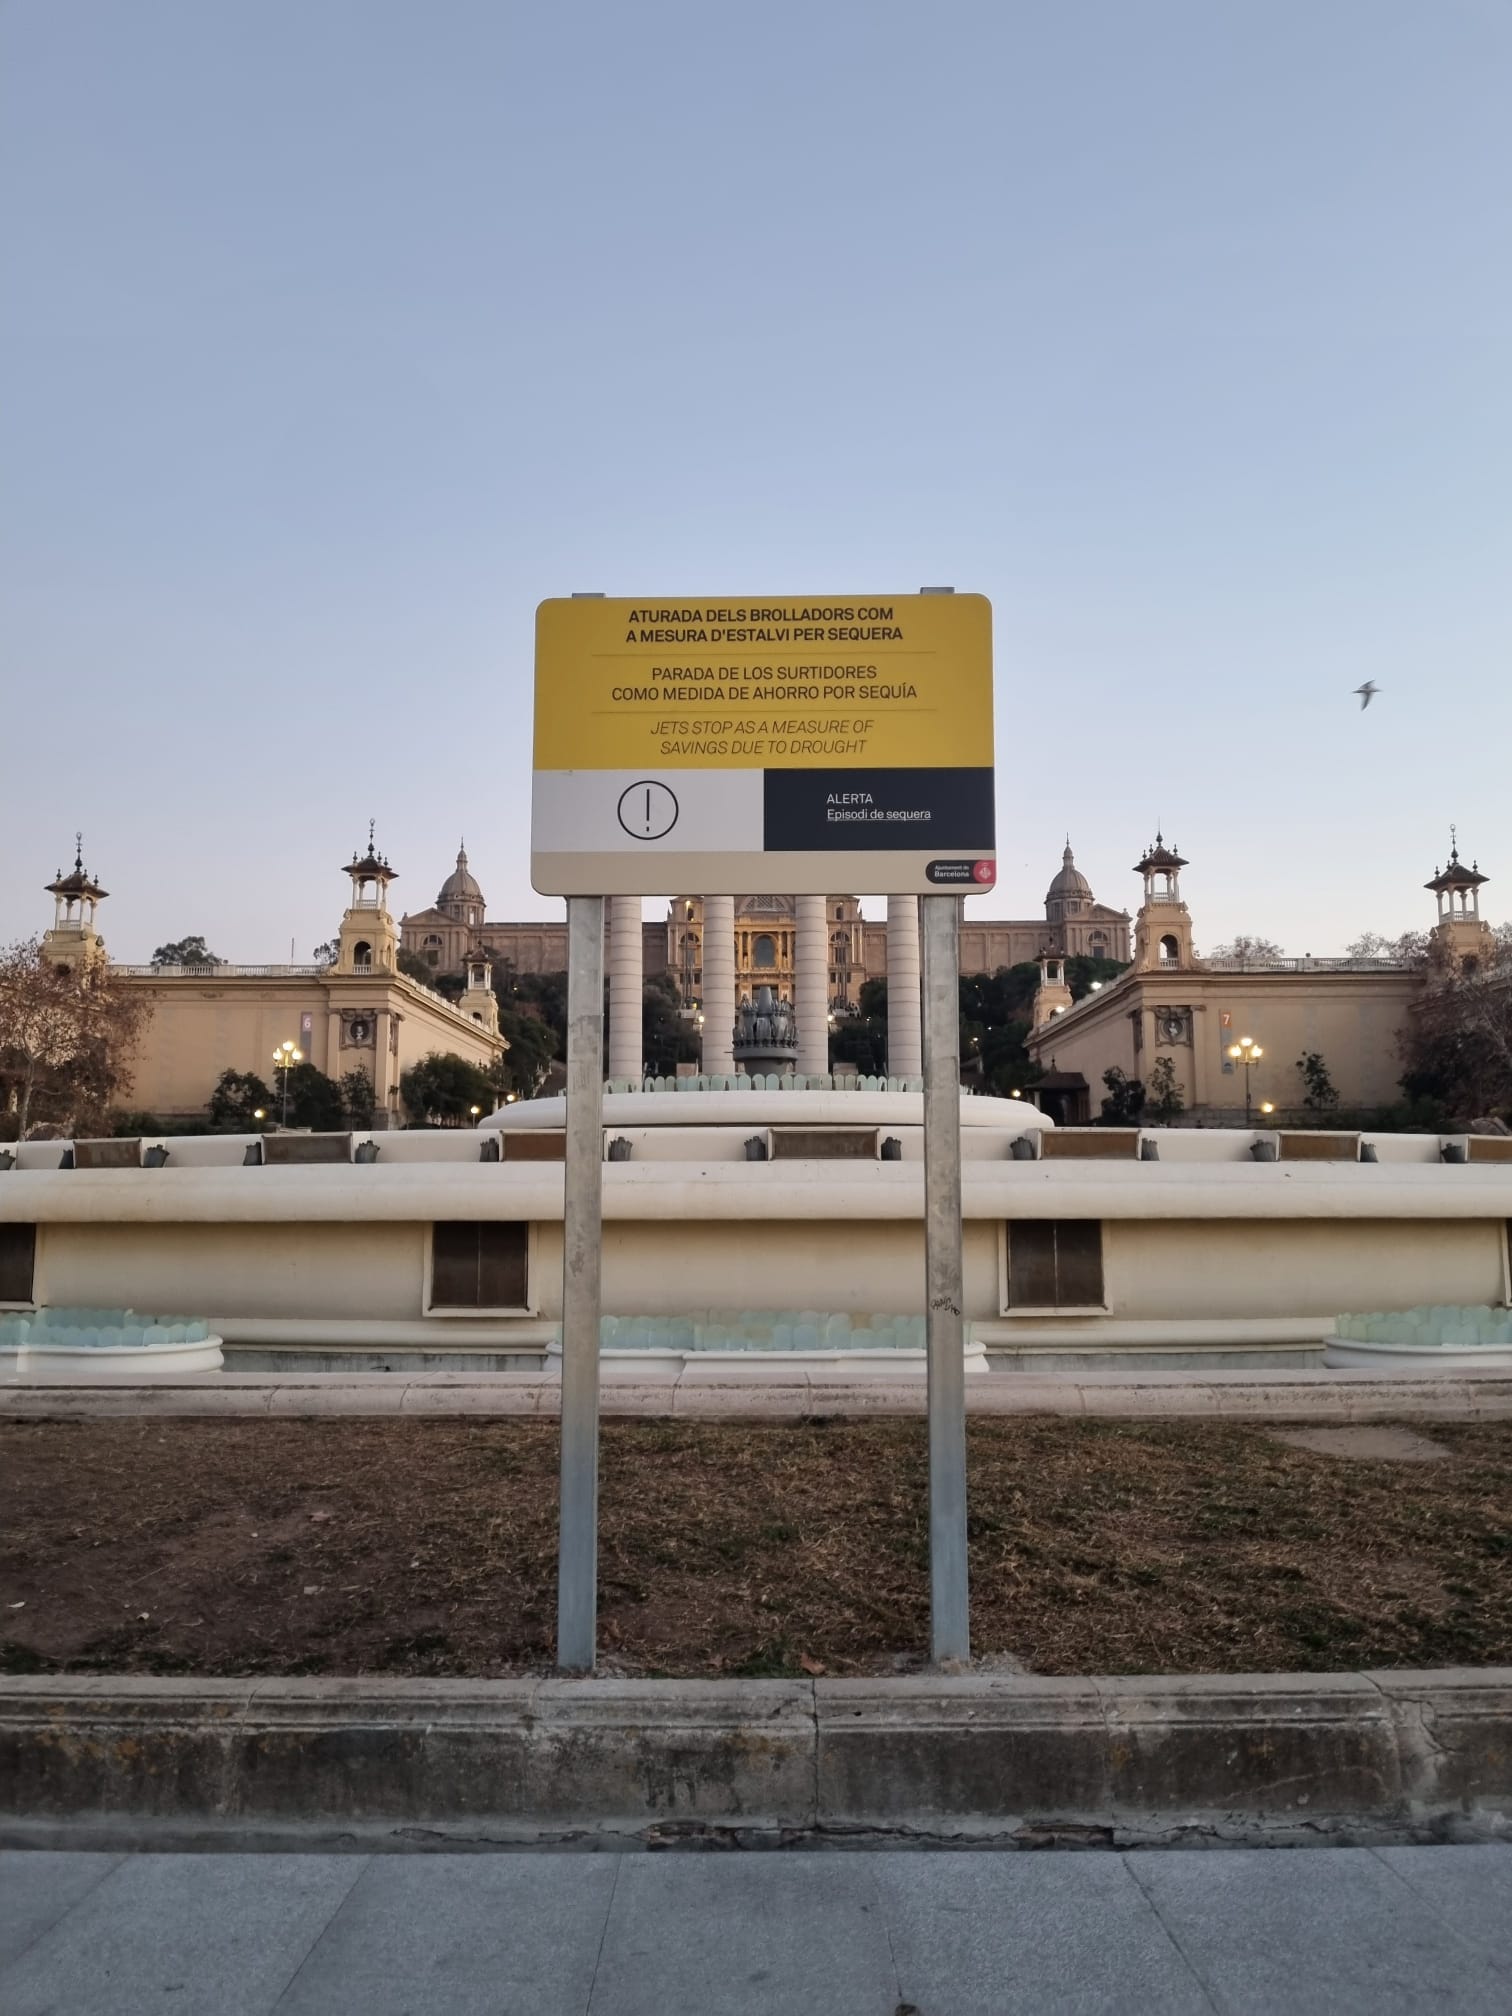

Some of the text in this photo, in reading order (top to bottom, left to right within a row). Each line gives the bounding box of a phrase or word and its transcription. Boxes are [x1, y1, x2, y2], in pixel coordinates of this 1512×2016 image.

[629, 607, 893, 623] ATURADA DELS BROLLADORS COM
[626, 627, 903, 643] A MESURA D'ESTALVI PER SEQUERA
[652, 665, 877, 680] PARADA DE LOS SURTIDORES
[612, 682, 917, 701] COMO MEDIDA DE AHORRO POR SEQUÍA
[651, 720, 874, 736] JETS STOP AS A MEASURE OF
[661, 740, 867, 755] SAVINGS DUE TO DROUGHT
[827, 793, 873, 804] ALERTA
[827, 808, 931, 821] Episodi de sequera
[304, 1017, 311, 1029] 6
[1223, 1014, 1230, 1025] 7
